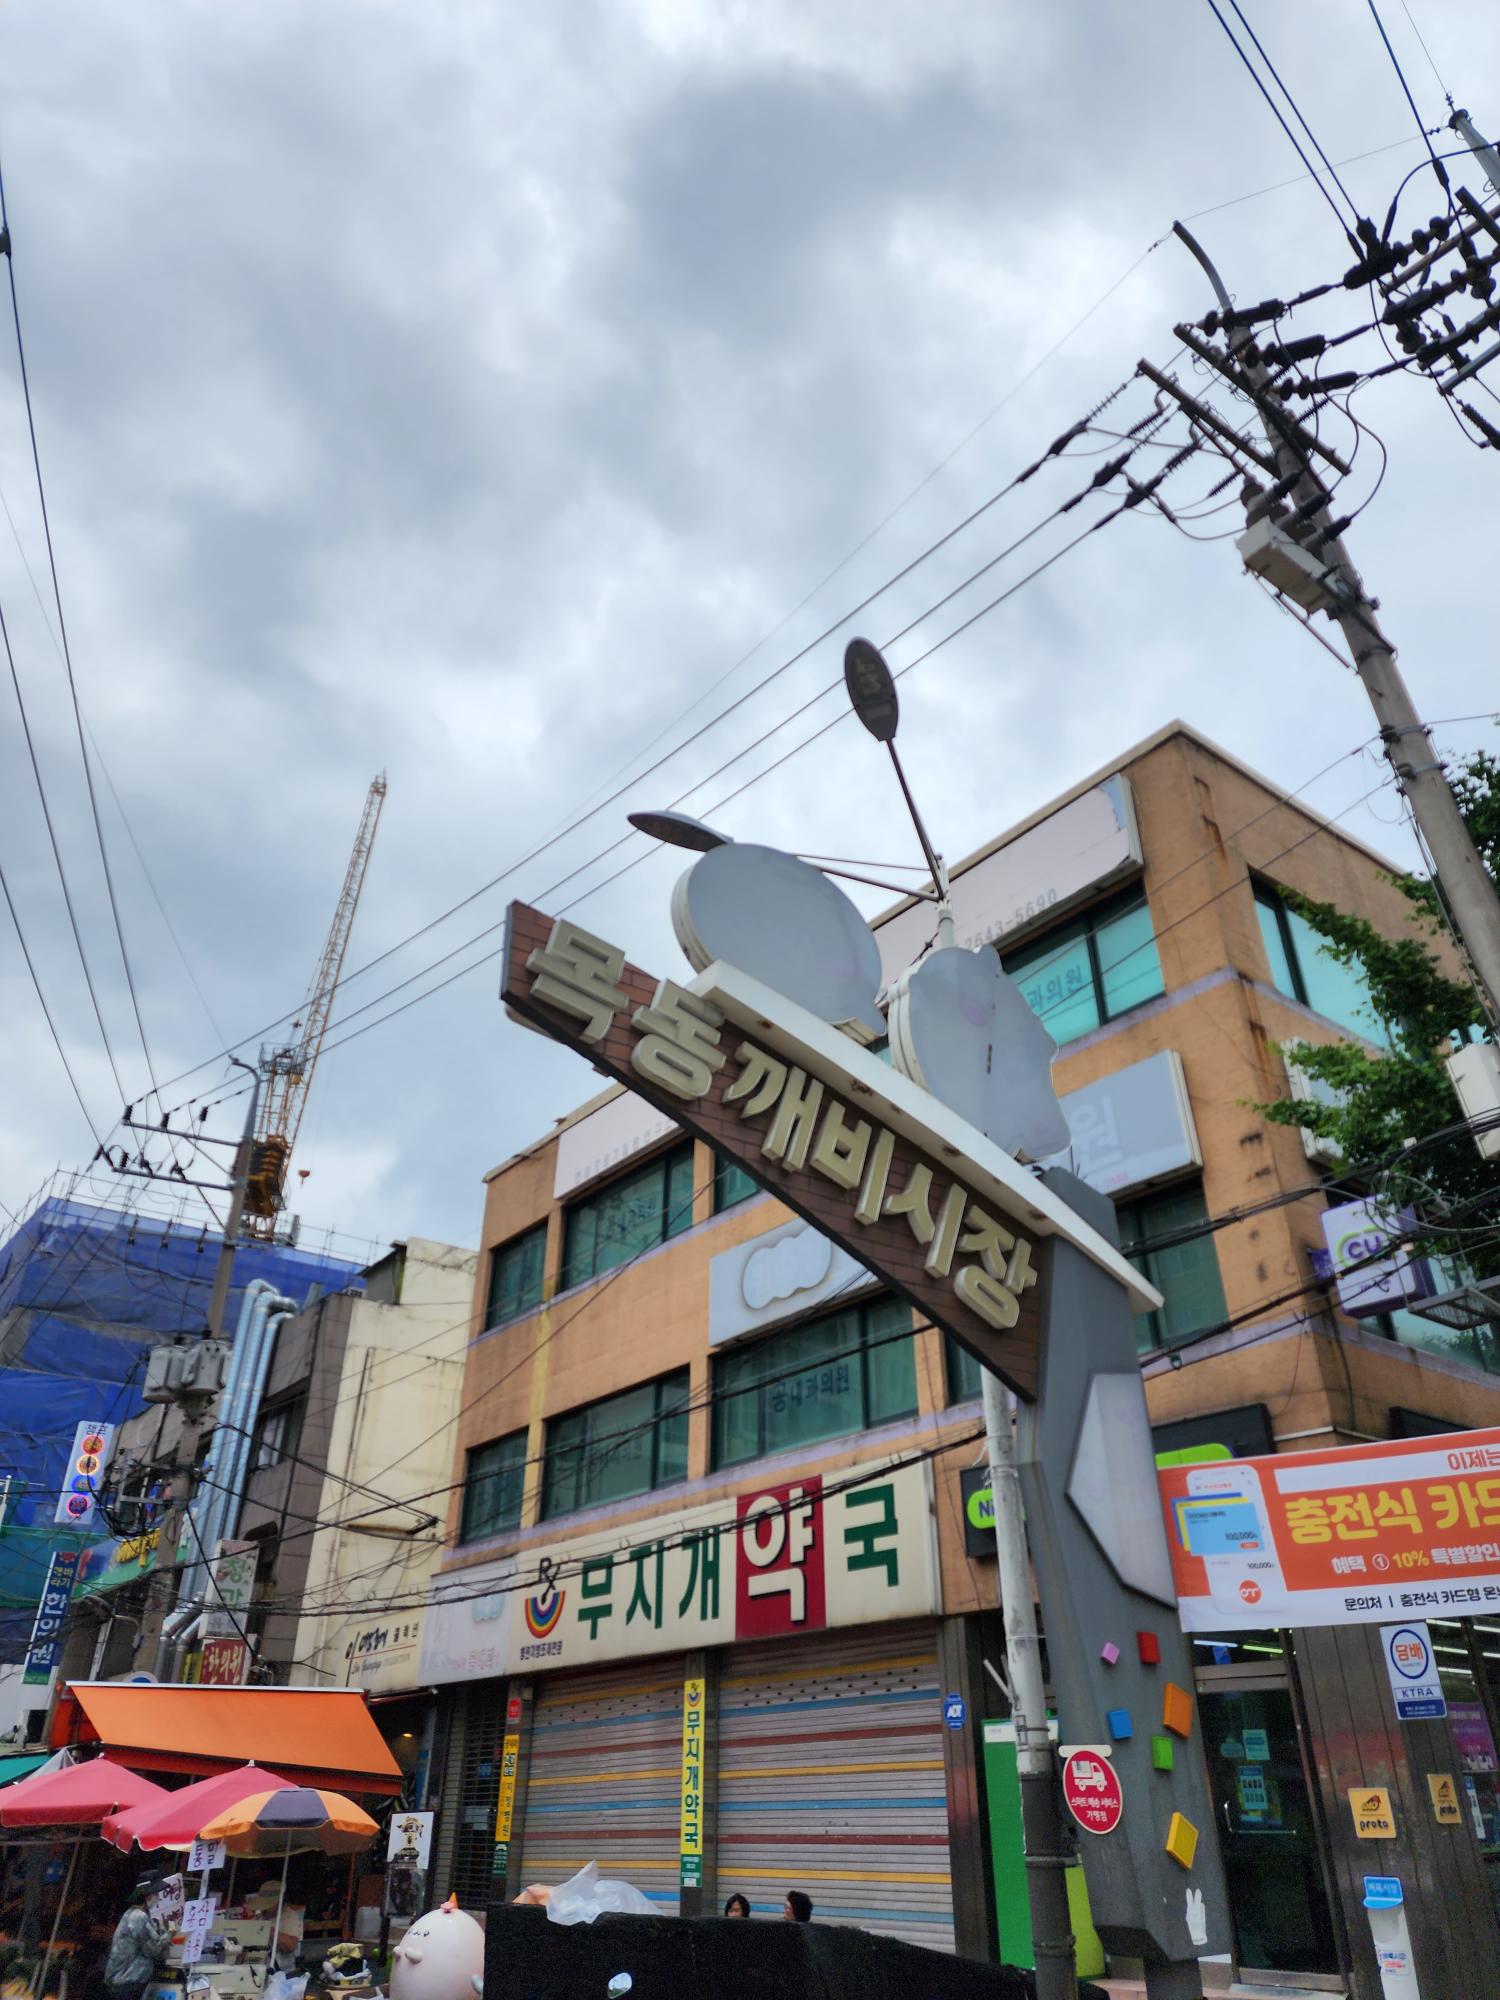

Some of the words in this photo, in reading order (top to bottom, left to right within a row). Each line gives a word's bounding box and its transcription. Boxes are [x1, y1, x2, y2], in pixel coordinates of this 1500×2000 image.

[526, 917, 1038, 1330] 목동깨비시장
[1348, 1235, 1380, 1259] CU
[1285, 1487, 1423, 1545] 충전식
[577, 1483, 899, 1641] 무지개약국
[1330, 1554, 1368, 1575] 혜택
[1393, 1549, 1431, 1569] 10%
[1344, 1595, 1383, 1612] 문의처
[1400, 1589, 1440, 1608] 충전식
[1395, 1642, 1424, 1661] 담배
[1402, 1687, 1434, 1698] KTRA
[684, 1711, 700, 1849] 무지개약국
[1359, 1818, 1390, 1832] proto
